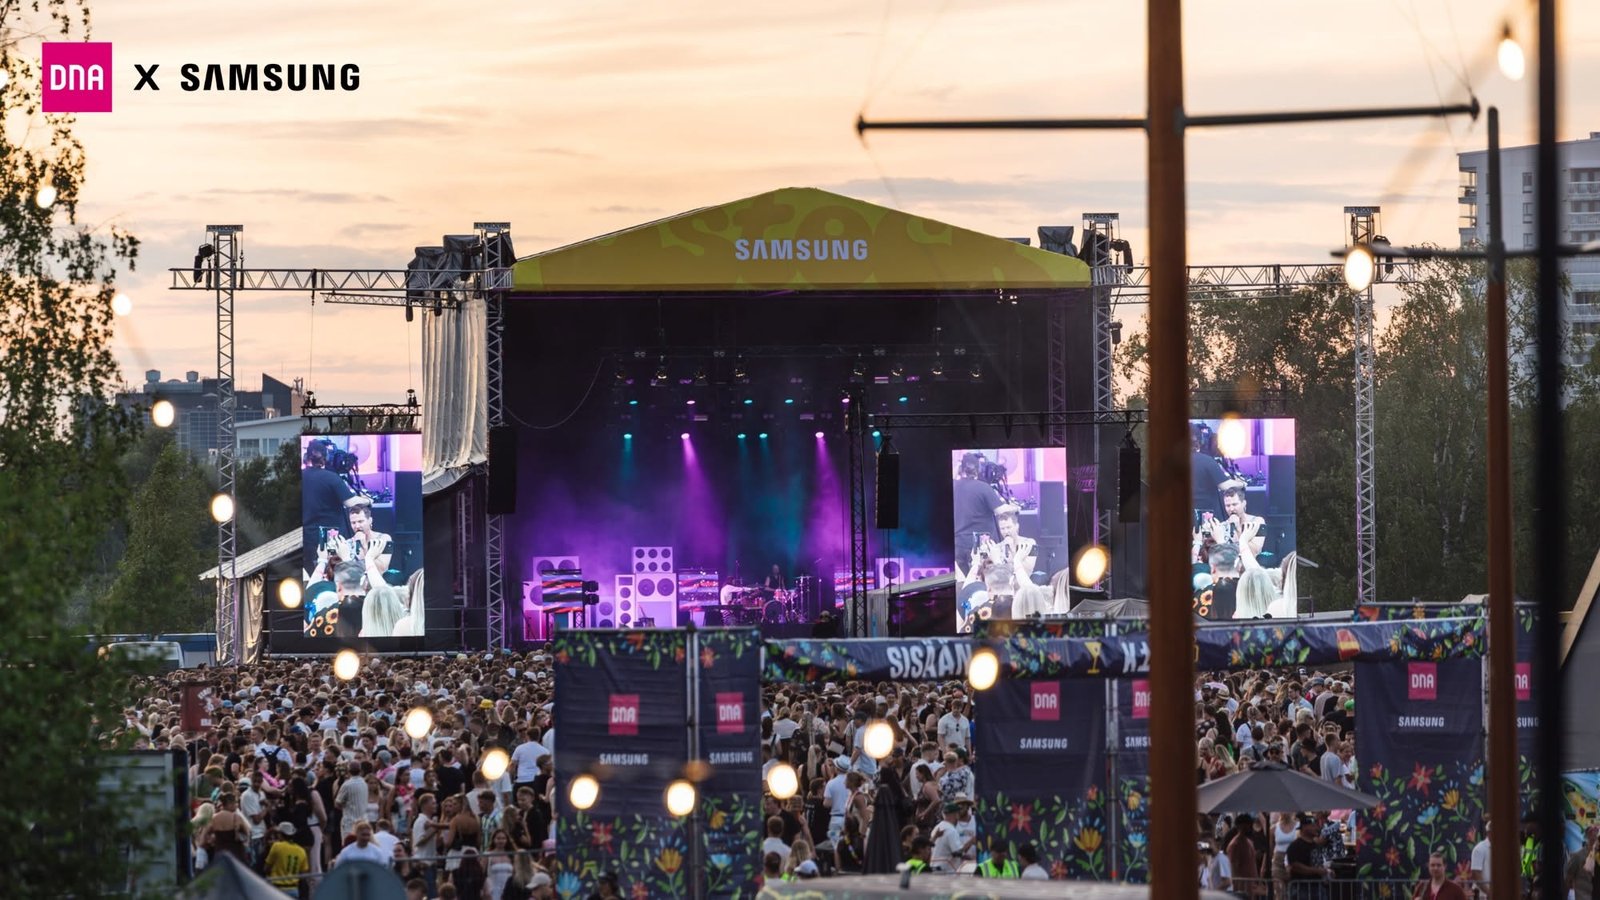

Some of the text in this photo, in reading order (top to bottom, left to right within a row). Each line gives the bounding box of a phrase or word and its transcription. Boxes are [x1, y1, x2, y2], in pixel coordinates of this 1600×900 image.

[735, 239, 868, 261] SAMSUNG
[1411, 674, 1434, 689] DNA
[1514, 673, 1528, 689] NA
[1034, 693, 1058, 709] DNA
[612, 706, 637, 723] DNA
[718, 705, 742, 721] DNA
[1398, 715, 1445, 728] SAMSUNG
[1516, 716, 1540, 728] SUNG
[1019, 737, 1068, 750] SAMSUNG
[1124, 736, 1152, 748] SAMS
[599, 753, 649, 765] SAMSUNG
[709, 752, 753, 764] SAMSUNG
